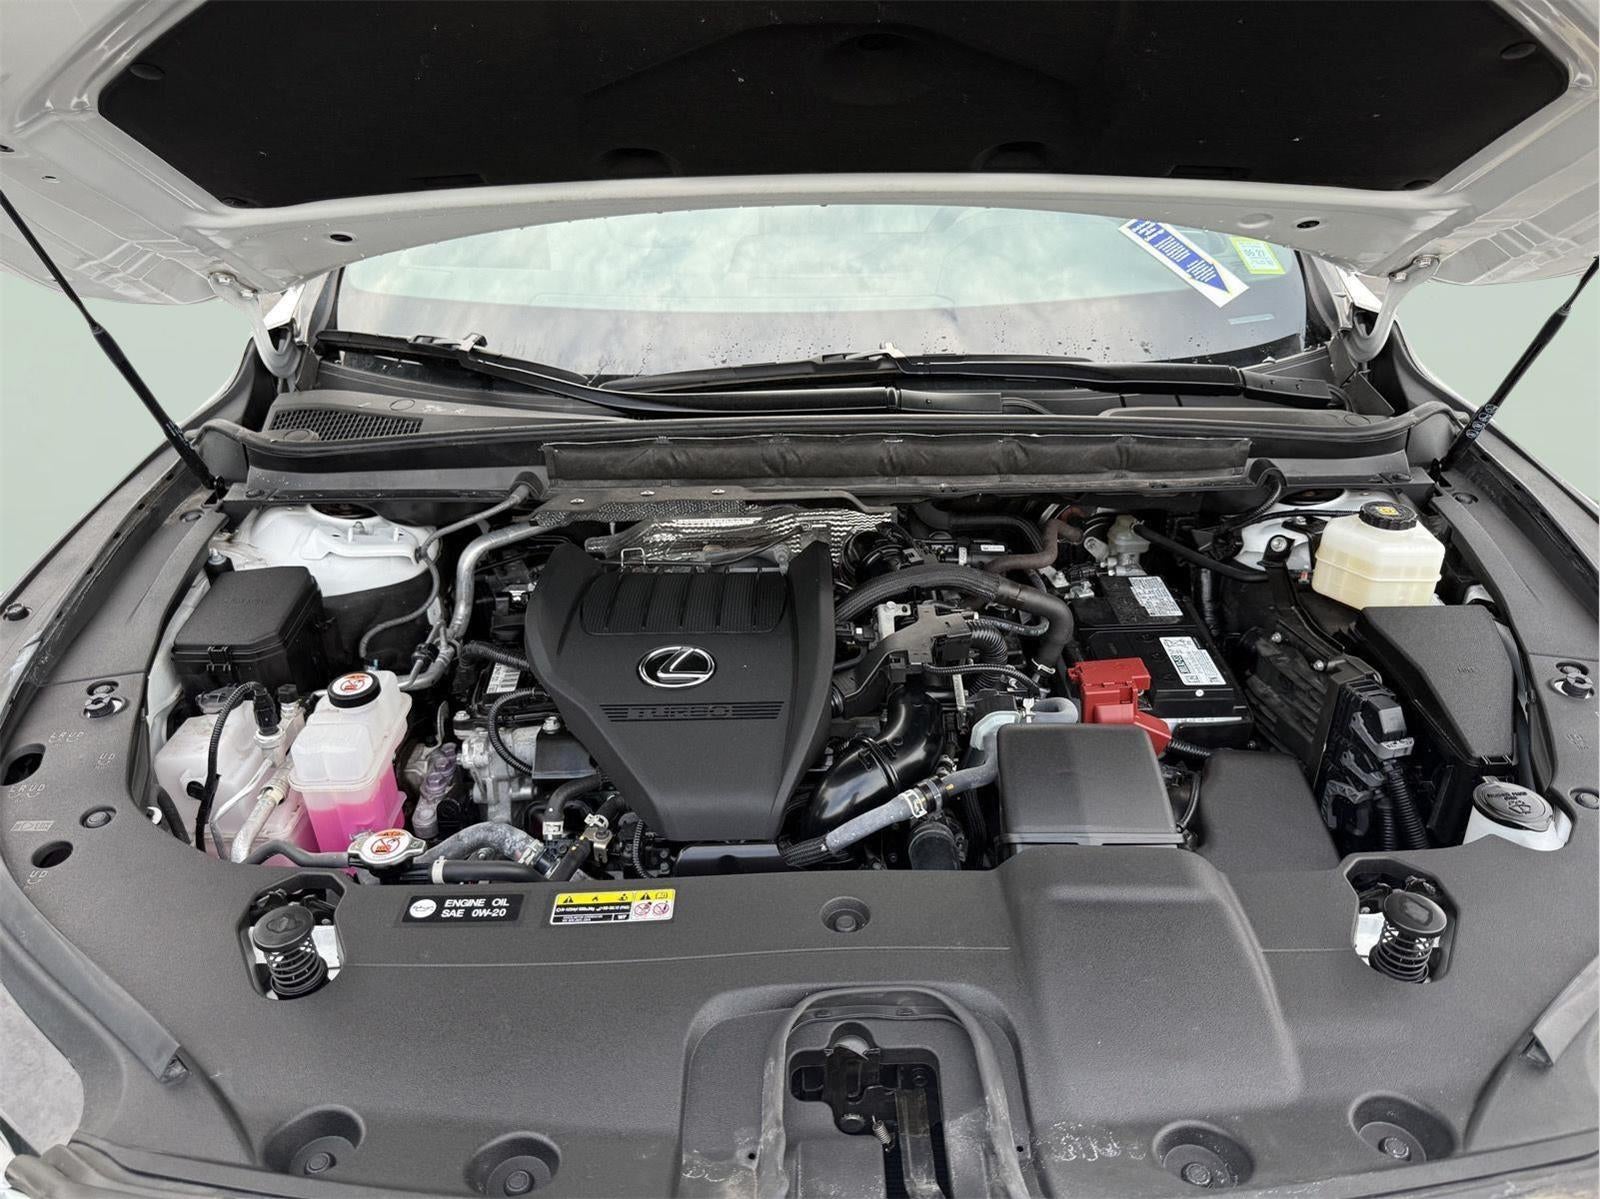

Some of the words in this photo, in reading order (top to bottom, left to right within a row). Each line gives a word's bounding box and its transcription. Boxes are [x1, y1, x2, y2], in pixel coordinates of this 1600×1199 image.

[628, 705, 733, 720] TURBO
[444, 898, 486, 907] ENGINE
[491, 897, 510, 907] OIL
[440, 908, 465, 918] SAE
[471, 908, 507, 917] 0W-20
